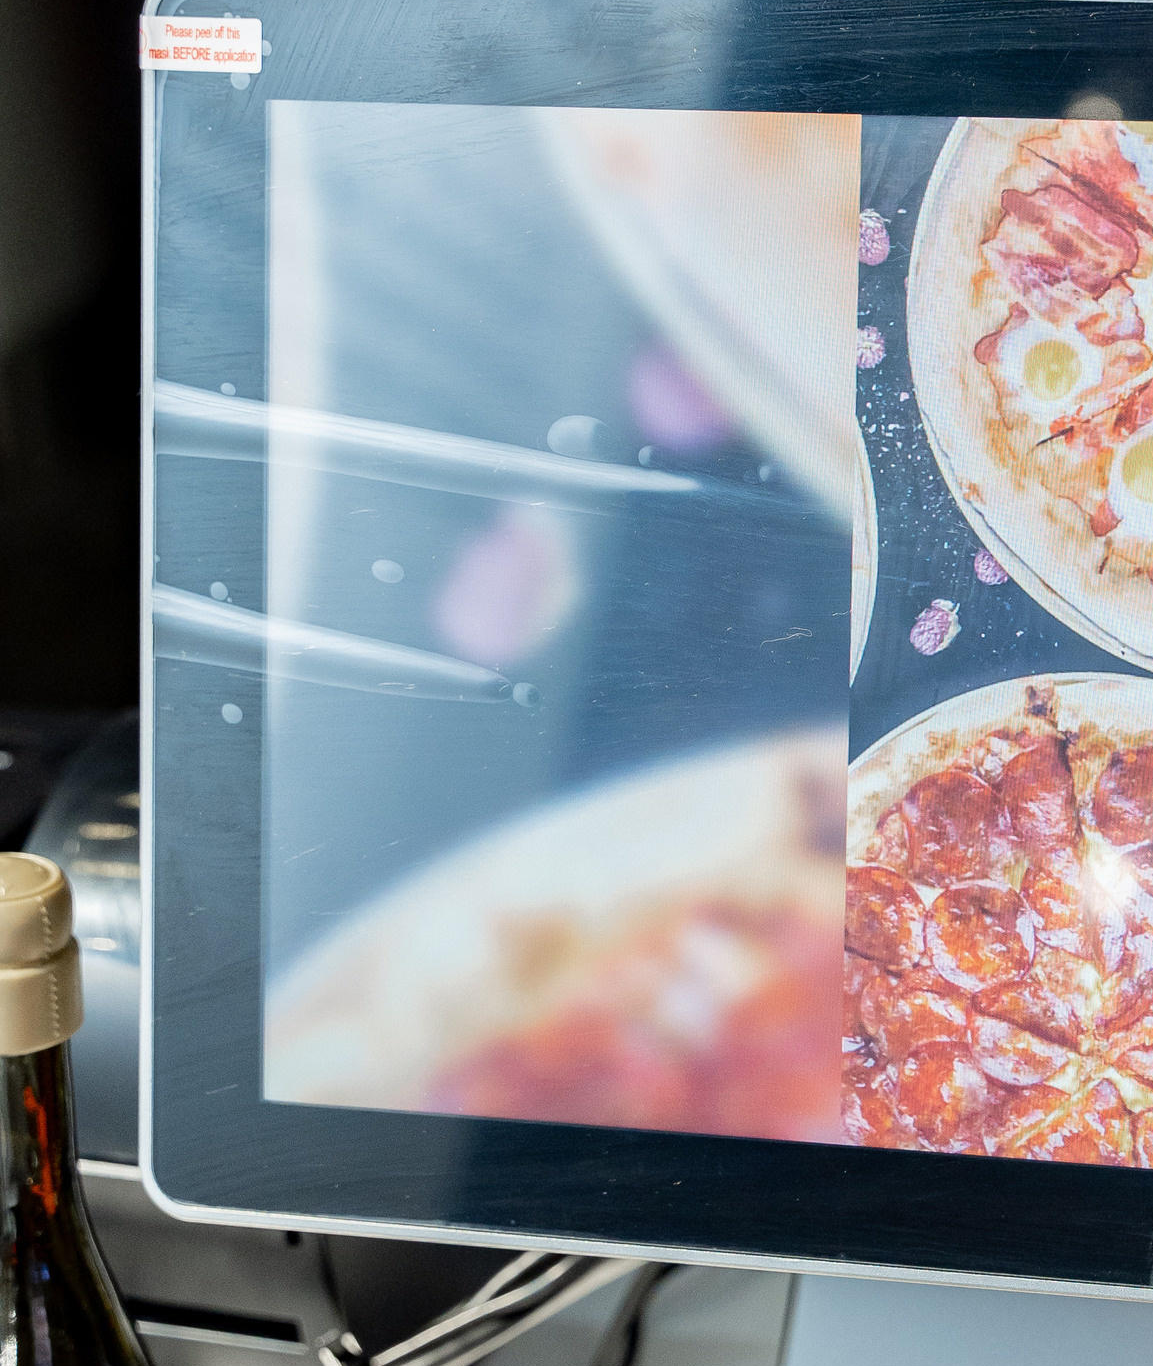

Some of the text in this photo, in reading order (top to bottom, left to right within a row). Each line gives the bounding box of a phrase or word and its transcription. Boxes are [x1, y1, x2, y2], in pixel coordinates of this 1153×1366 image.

[166, 24, 193, 38] Please
[195, 27, 212, 40] peel
[226, 27, 240, 39] this
[149, 46, 257, 64] mask BEFORE application
